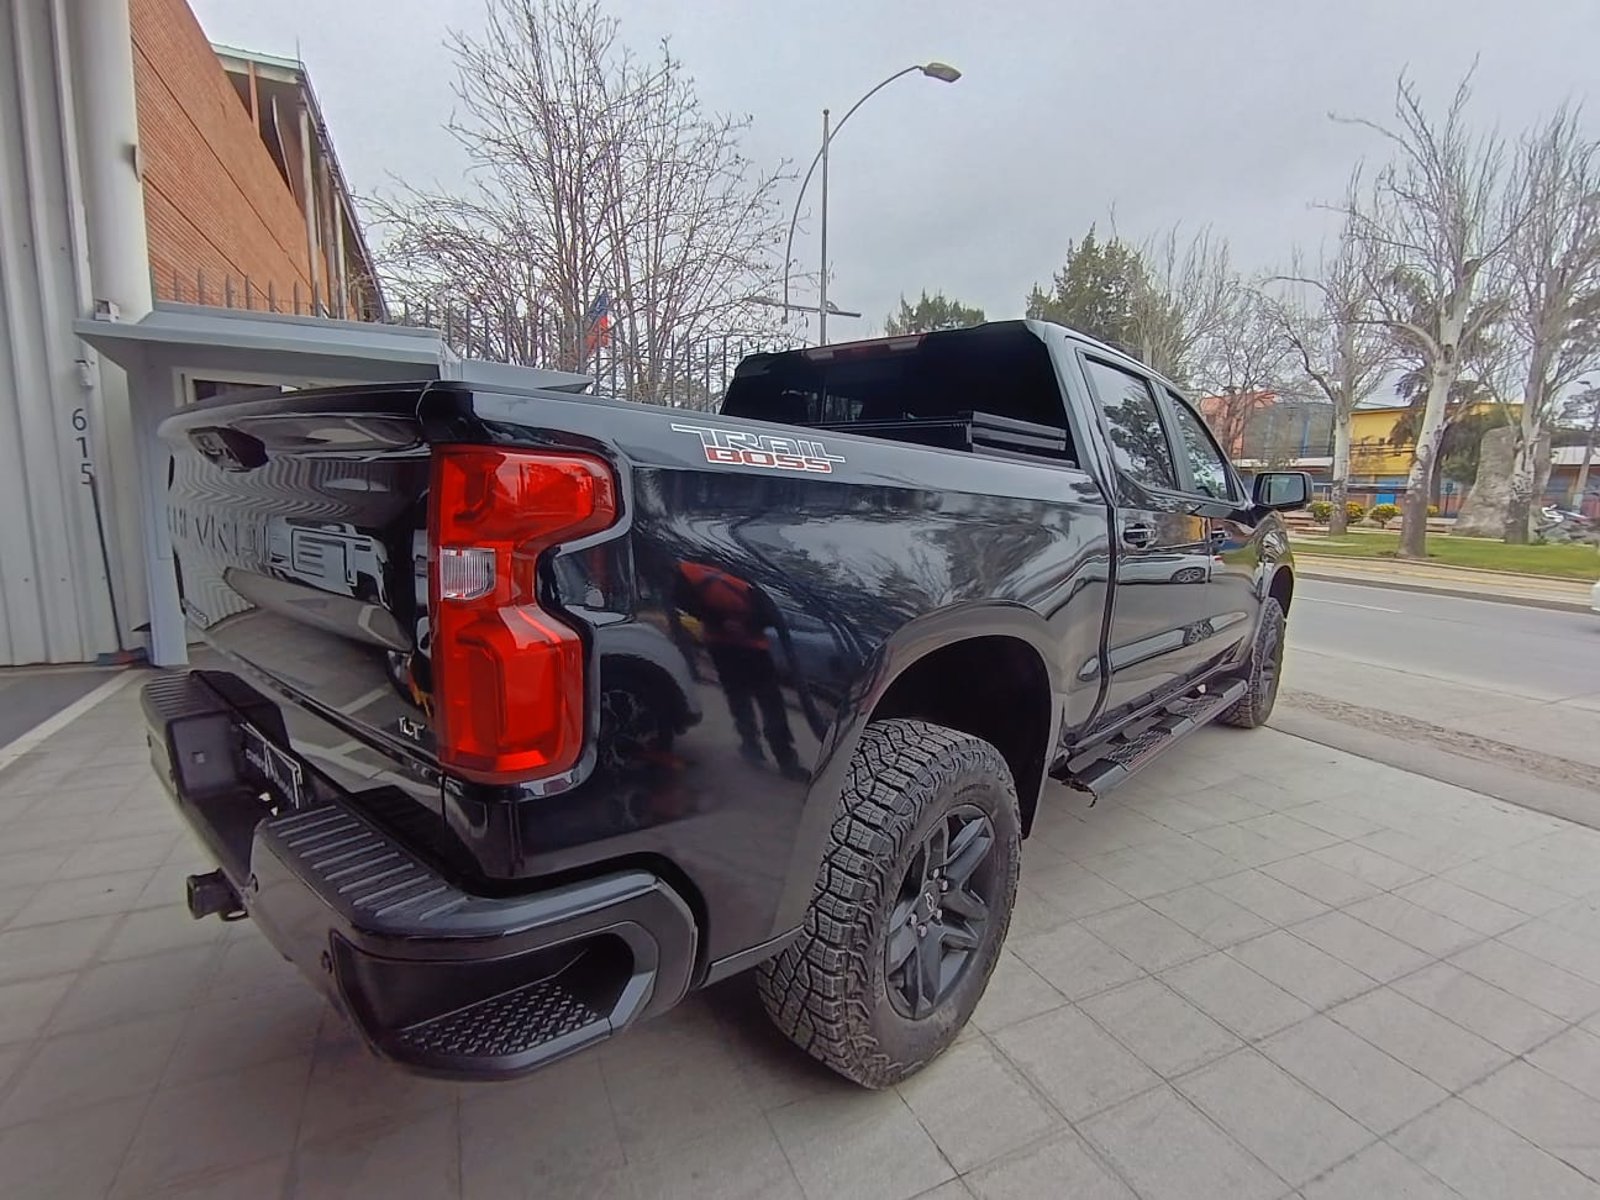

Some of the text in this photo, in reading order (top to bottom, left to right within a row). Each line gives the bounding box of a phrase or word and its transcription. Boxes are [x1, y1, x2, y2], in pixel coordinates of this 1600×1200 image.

[72, 408, 93, 485] 615
[670, 423, 846, 463] TRAIL
[705, 447, 832, 474] BOSS
[399, 716, 425, 740] LT
